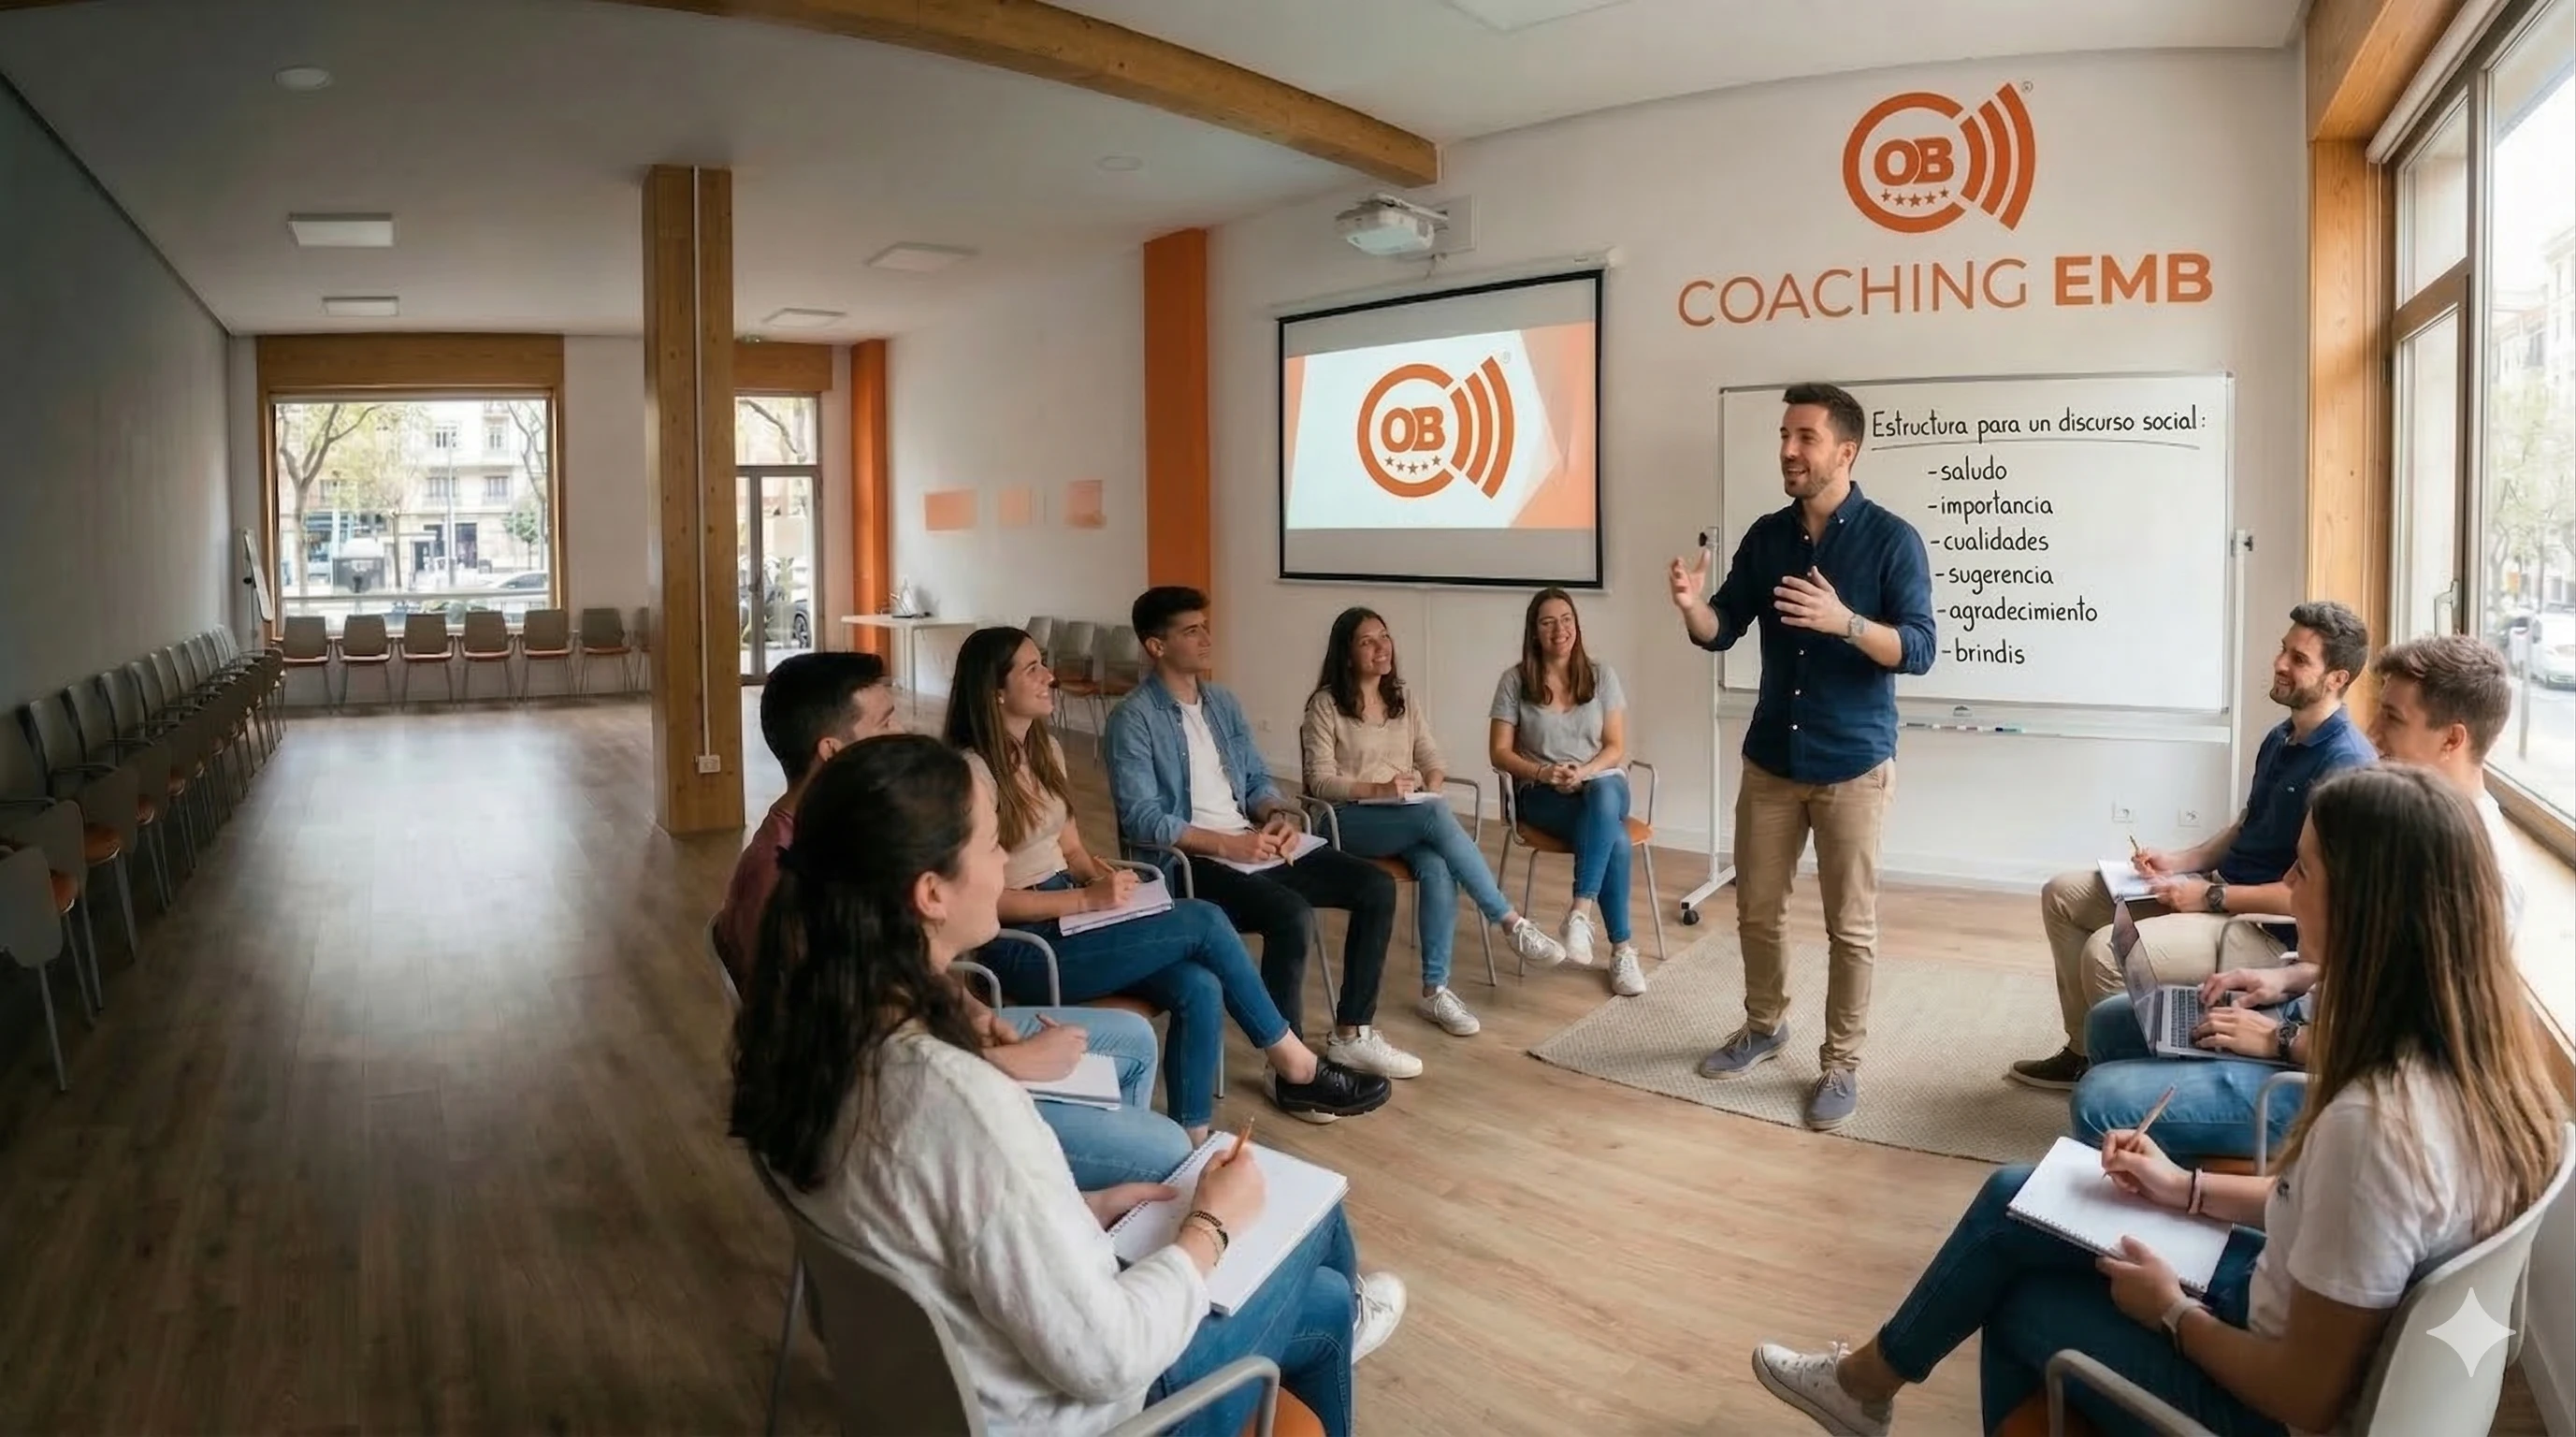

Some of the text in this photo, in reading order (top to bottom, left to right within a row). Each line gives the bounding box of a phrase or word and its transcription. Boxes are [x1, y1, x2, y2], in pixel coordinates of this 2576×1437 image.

[1679, 253, 2214, 327] COACHING EMB
[1872, 403, 2207, 444] Estructura para un discurso social:
